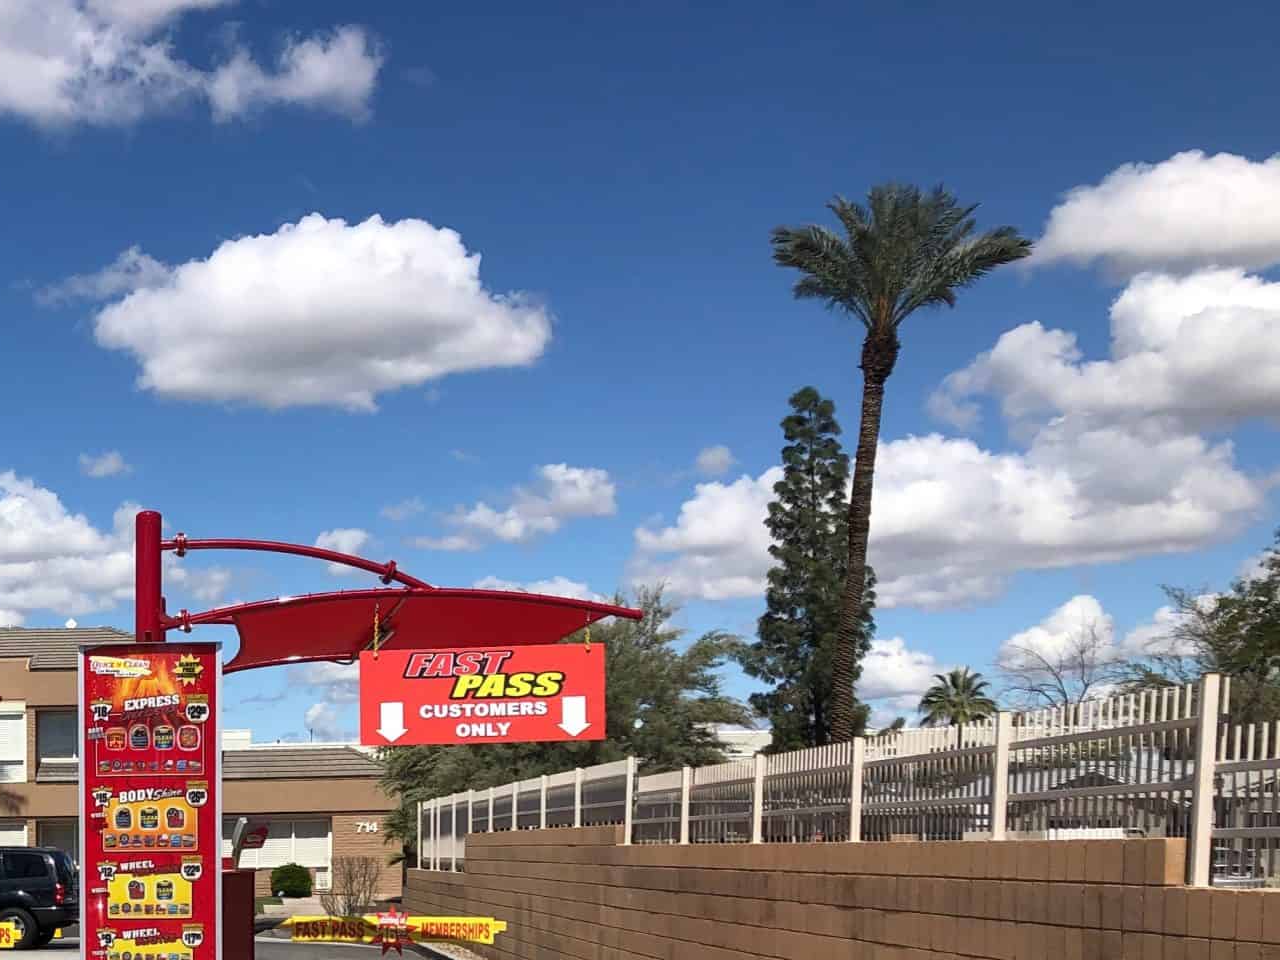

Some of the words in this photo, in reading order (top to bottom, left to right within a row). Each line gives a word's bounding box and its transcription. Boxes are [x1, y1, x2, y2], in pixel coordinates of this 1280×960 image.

[404, 651, 513, 678] FAST
[450, 671, 565, 699] PASS
[124, 695, 180, 711] EXPRESS
[419, 701, 547, 718] CUSTOMERS
[456, 722, 511, 737] ONLY
[119, 788, 155, 803] BODY
[355, 821, 378, 833] 714
[120, 860, 155, 871] WHEEL
[122, 928, 160, 939] WHEEL
[295, 920, 330, 937] FAST
[332, 920, 365, 937] PASS
[421, 922, 491, 939] MEMBERSHIPS
